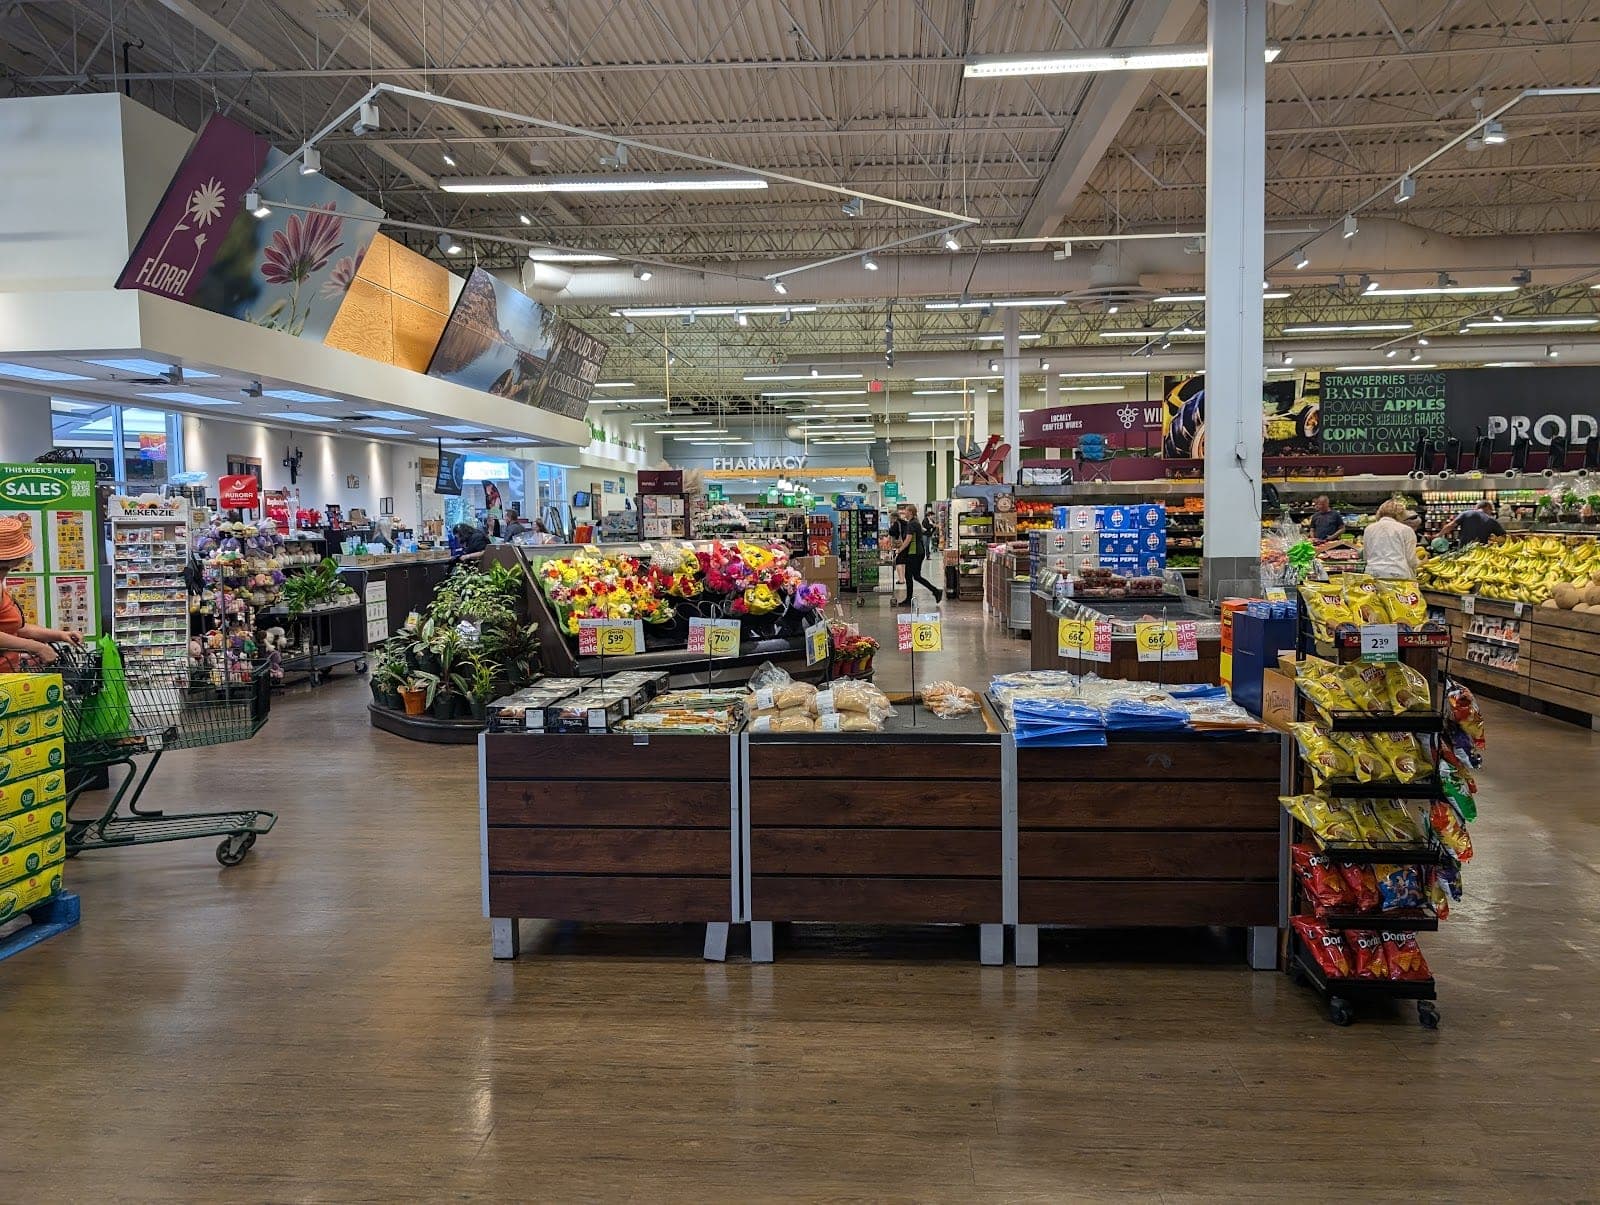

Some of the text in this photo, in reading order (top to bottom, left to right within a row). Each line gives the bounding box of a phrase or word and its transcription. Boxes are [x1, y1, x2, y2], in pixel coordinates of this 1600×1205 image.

[135, 257, 187, 296] FLORAL
[1325, 373, 1447, 387] STRAWBERRIES BEANS
[1326, 385, 1446, 400] BASIL SPINACH
[1323, 398, 1446, 413] ROMAINE APPLES
[1050, 413, 1073, 423] LOCALLY
[1322, 413, 1374, 427] PEPPERS
[1413, 412, 1446, 425] GRAPES
[1322, 427, 1369, 441] CORN
[1487, 414, 1599, 446] PROD
[1376, 441, 1445, 453] GARC
[4, 466, 23, 474] THIS
[712, 456, 806, 470] PHARMACY
[5, 482, 62, 496] SALES
[579, 636, 597, 645] sale
[689, 635, 705, 643] sale
[898, 641, 913, 650] sale
[579, 644, 598, 653] sale
[687, 642, 705, 652] sale
